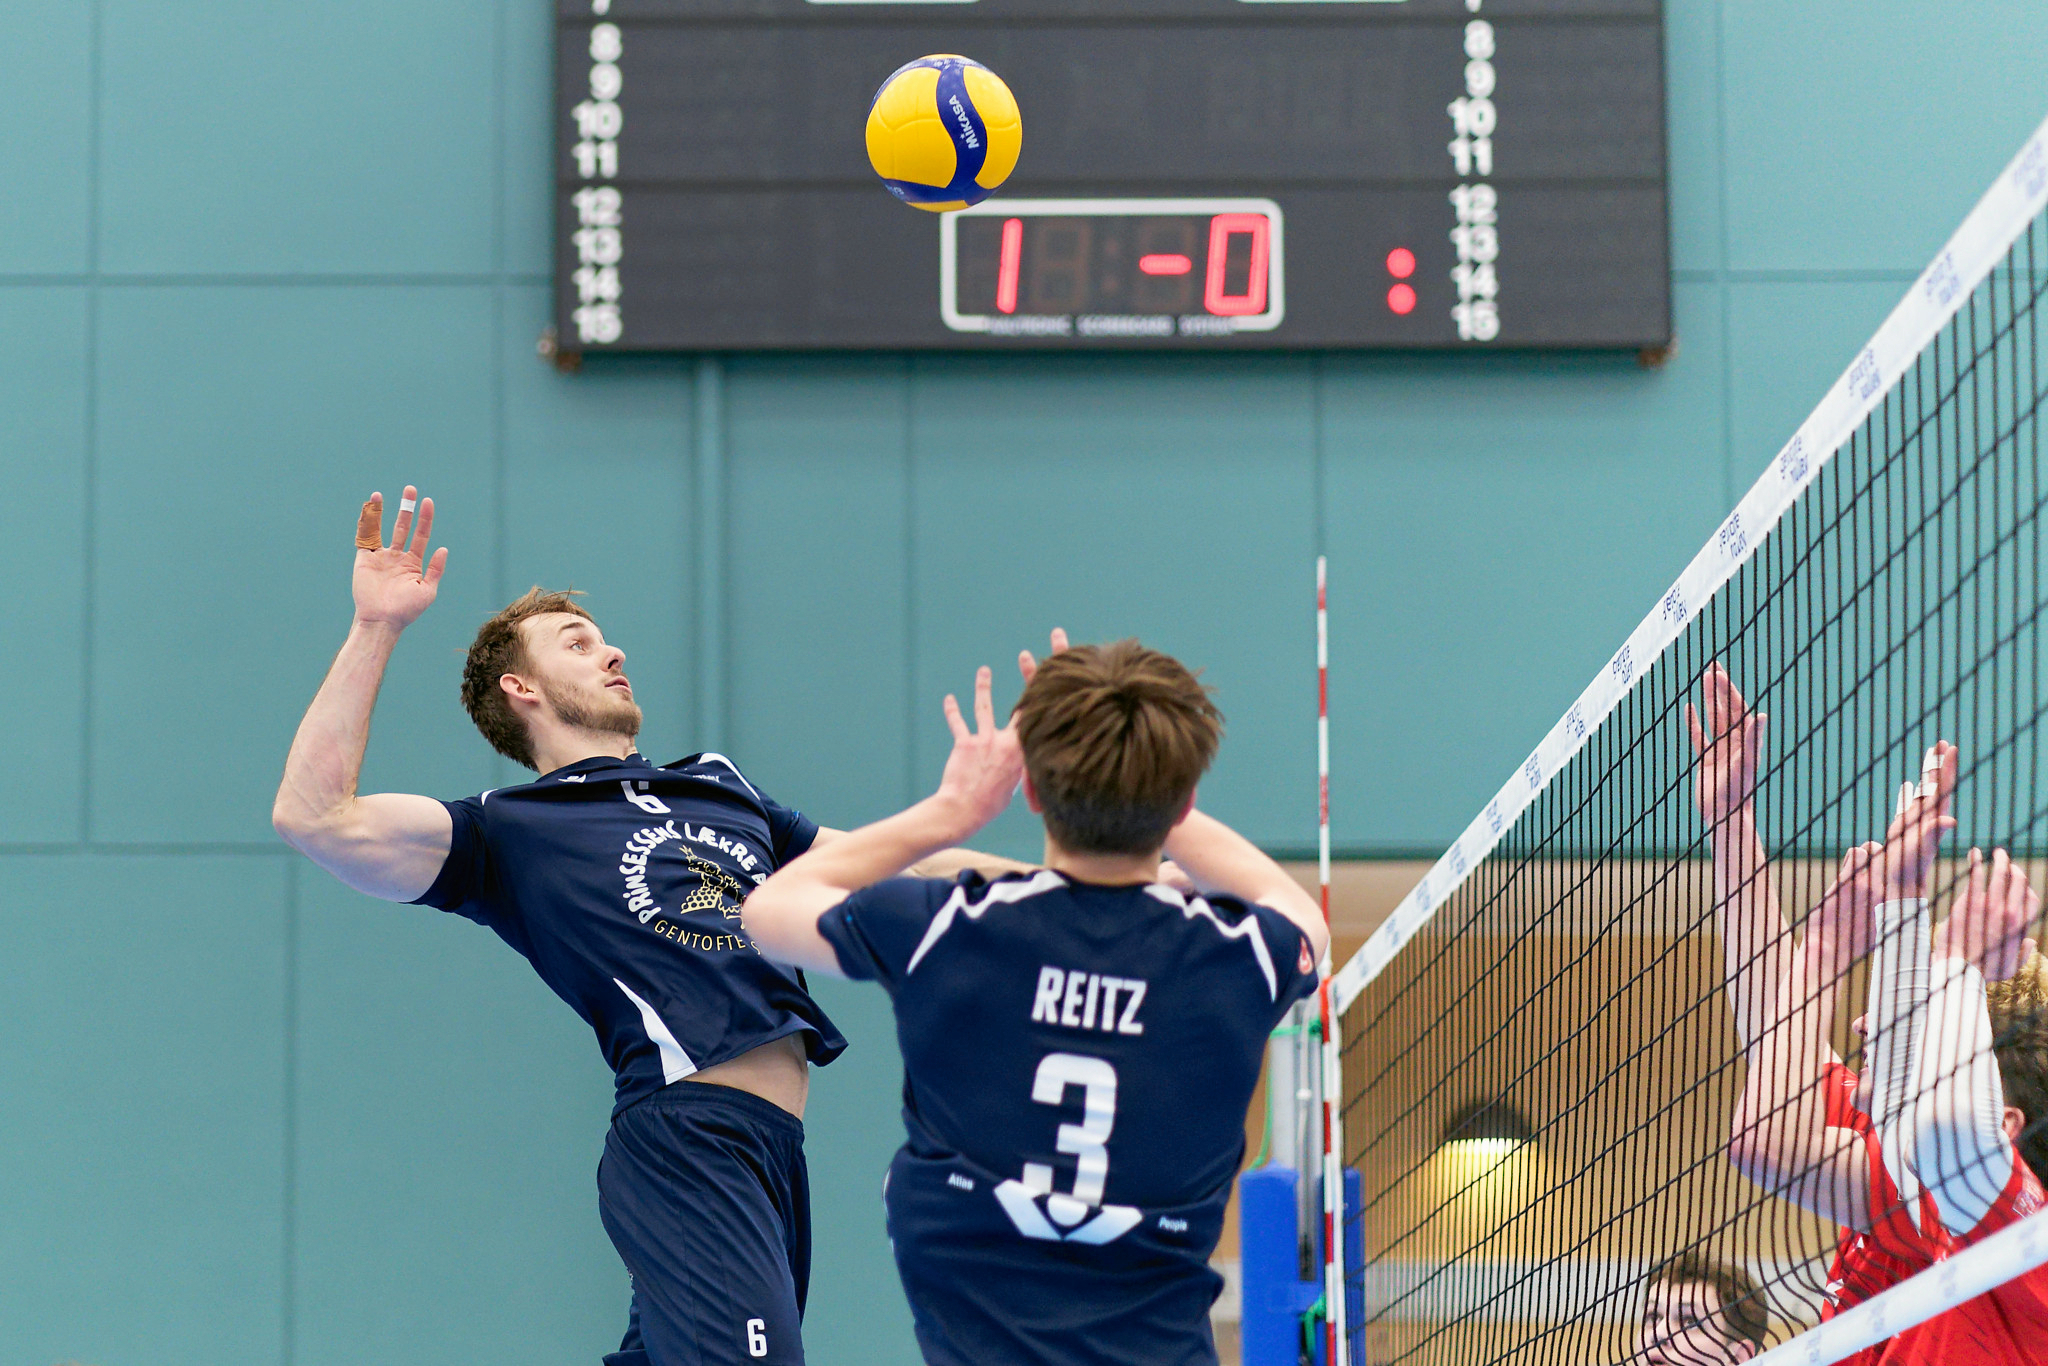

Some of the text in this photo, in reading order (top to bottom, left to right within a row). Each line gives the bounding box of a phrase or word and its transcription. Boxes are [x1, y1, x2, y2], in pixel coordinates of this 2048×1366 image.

[589, 22, 623, 62] 8
[1464, 19, 1495, 58] 8
[589, 62, 623, 100] 9
[1464, 58, 1496, 97] 9
[570, 99, 623, 139] 10
[948, 94, 979, 149] MIKASA
[1446, 96, 1497, 137] 10
[571, 139, 619, 179] 11
[1447, 137, 1493, 176] 11
[571, 187, 622, 225] 12
[1448, 184, 1497, 223] 12
[571, 226, 622, 264] 13
[1449, 225, 1498, 262] 13
[571, 265, 622, 302] 14
[996, 217, 1023, 314] 1
[1204, 213, 1270, 317] 0
[1449, 263, 1499, 300] 14
[571, 302, 623, 342] 15
[1450, 300, 1500, 341] 15
[684, 822, 758, 871] LÆKRE
[654, 919, 746, 952] GENTOFTE
[1031, 965, 1147, 1036] REITZ
[1022, 1051, 1118, 1208] 3
[746, 1318, 768, 1358] 6
